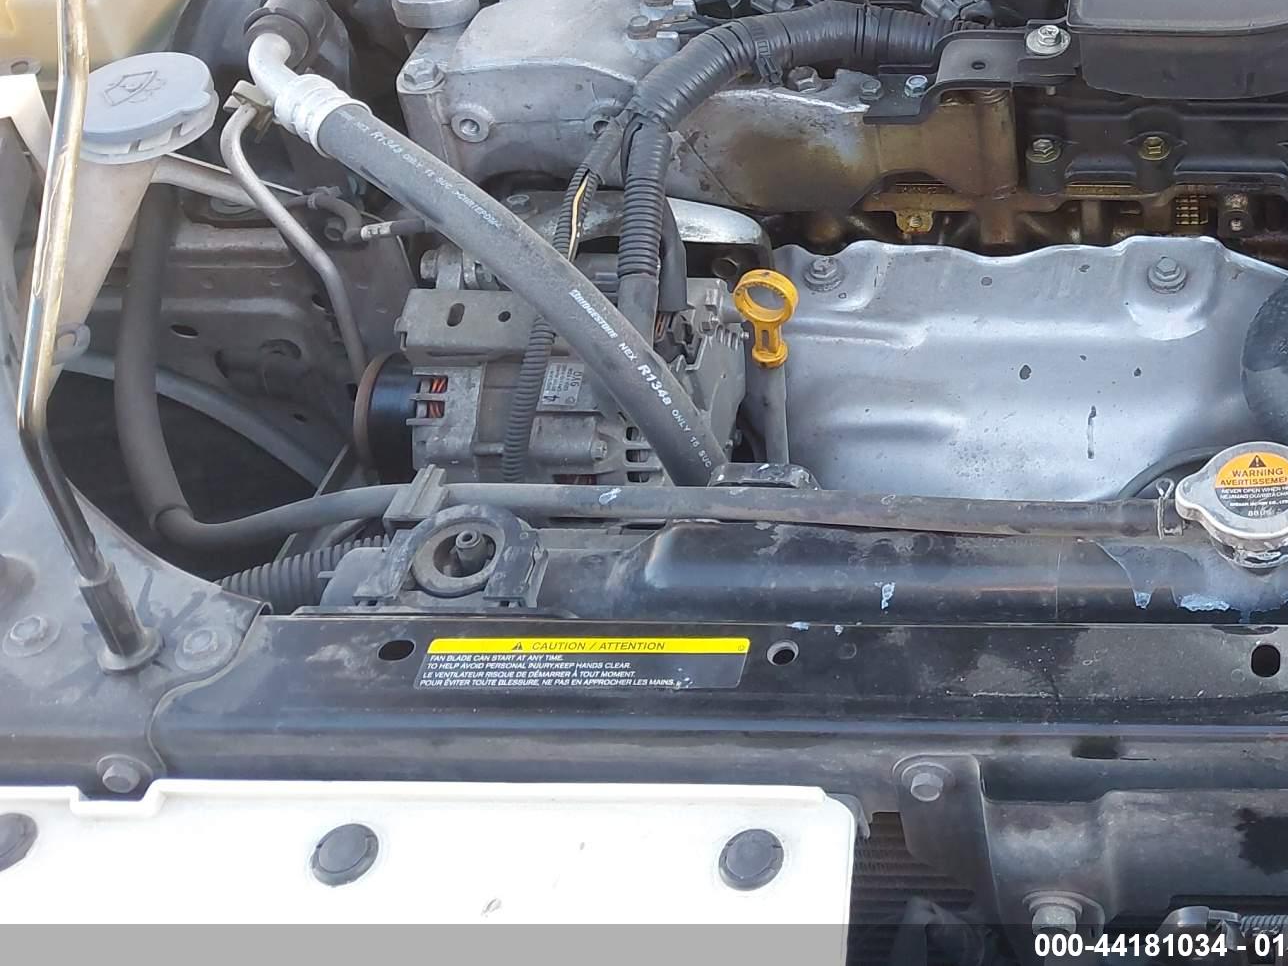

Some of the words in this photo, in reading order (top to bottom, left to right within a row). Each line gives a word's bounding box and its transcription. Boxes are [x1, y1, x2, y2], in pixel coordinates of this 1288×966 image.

[618, 342, 638, 361] NEX
[637, 364, 673, 406] R134a
[671, 409, 692, 432] ONLY
[698, 450, 713, 468] SUC
[1233, 468, 1283, 477] WARNING
[532, 641, 586, 651] CAUTION
[589, 641, 598, 651] /
[599, 641, 666, 651] ATTENTION
[423, 671, 434, 679] LE
[434, 671, 484, 679] VENTILATEUR
[486, 671, 514, 679] RISQUE
[515, 671, 527, 679] DE
[528, 670, 572, 679] DÉMARRER
[443, 678, 471, 686] ÉVITER
